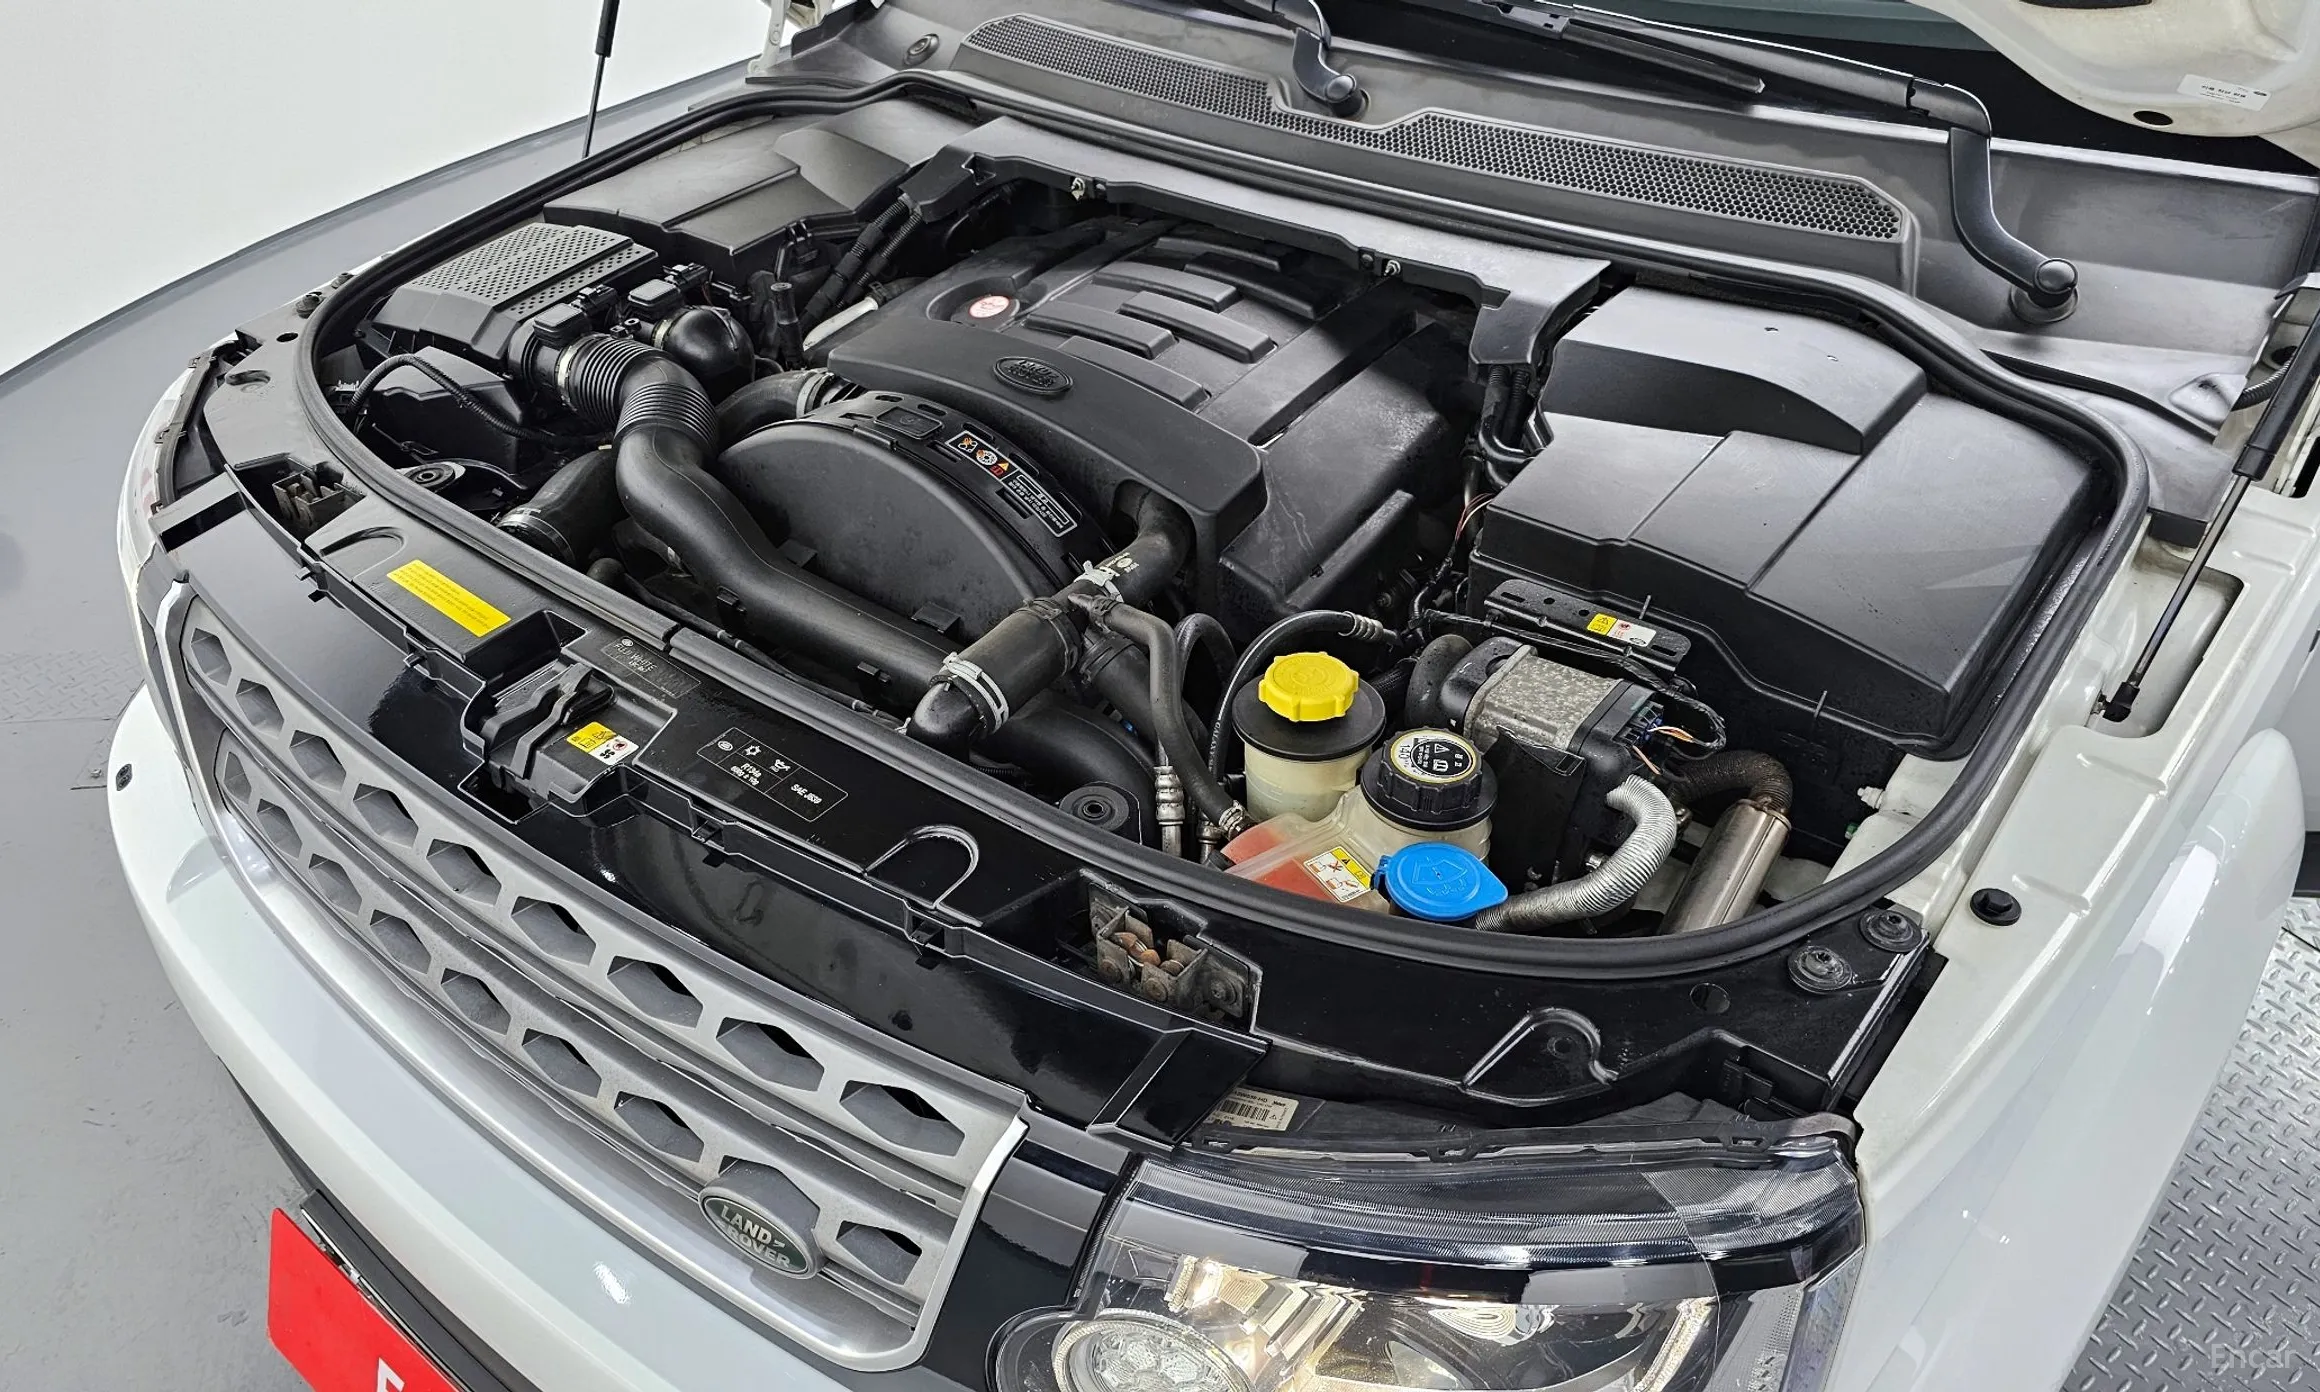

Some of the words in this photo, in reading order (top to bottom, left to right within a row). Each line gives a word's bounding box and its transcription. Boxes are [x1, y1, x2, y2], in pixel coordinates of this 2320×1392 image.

[630, 652, 658, 671] WHITE
[740, 762, 762, 778] R134a
[790, 783, 807, 796] SAE
[720, 1204, 772, 1245] LAND
[726, 1227, 791, 1269] ROVER
